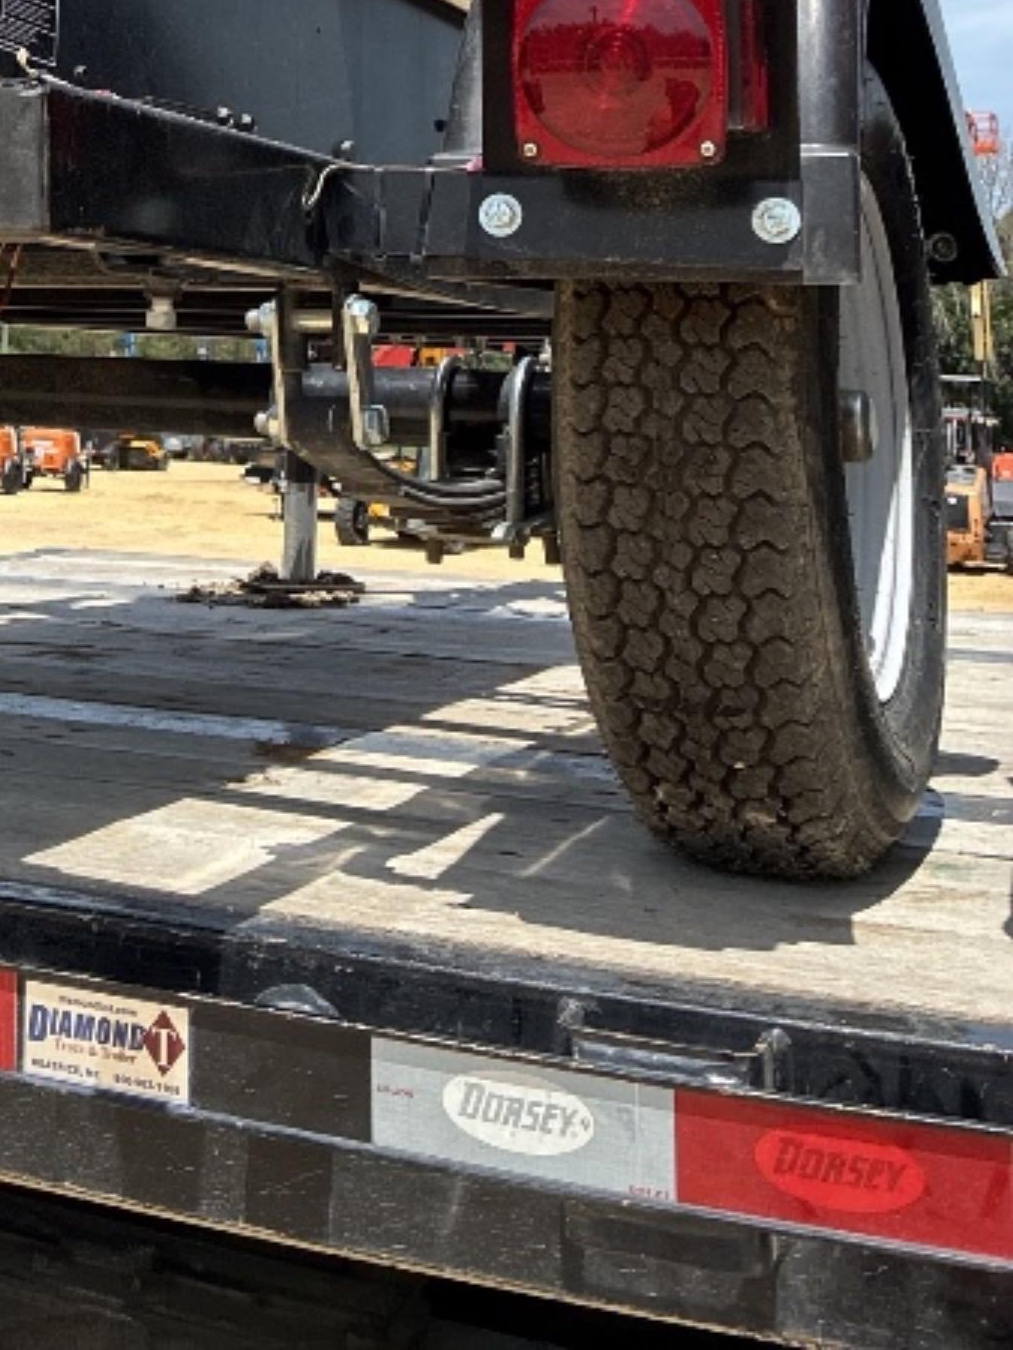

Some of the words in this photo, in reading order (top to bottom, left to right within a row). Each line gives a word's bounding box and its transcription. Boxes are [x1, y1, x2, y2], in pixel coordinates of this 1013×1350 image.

[28, 1003, 146, 1051] DIAMOND
[458, 1080, 577, 1136] DORSEY
[773, 1136, 907, 1193] DORSEY
